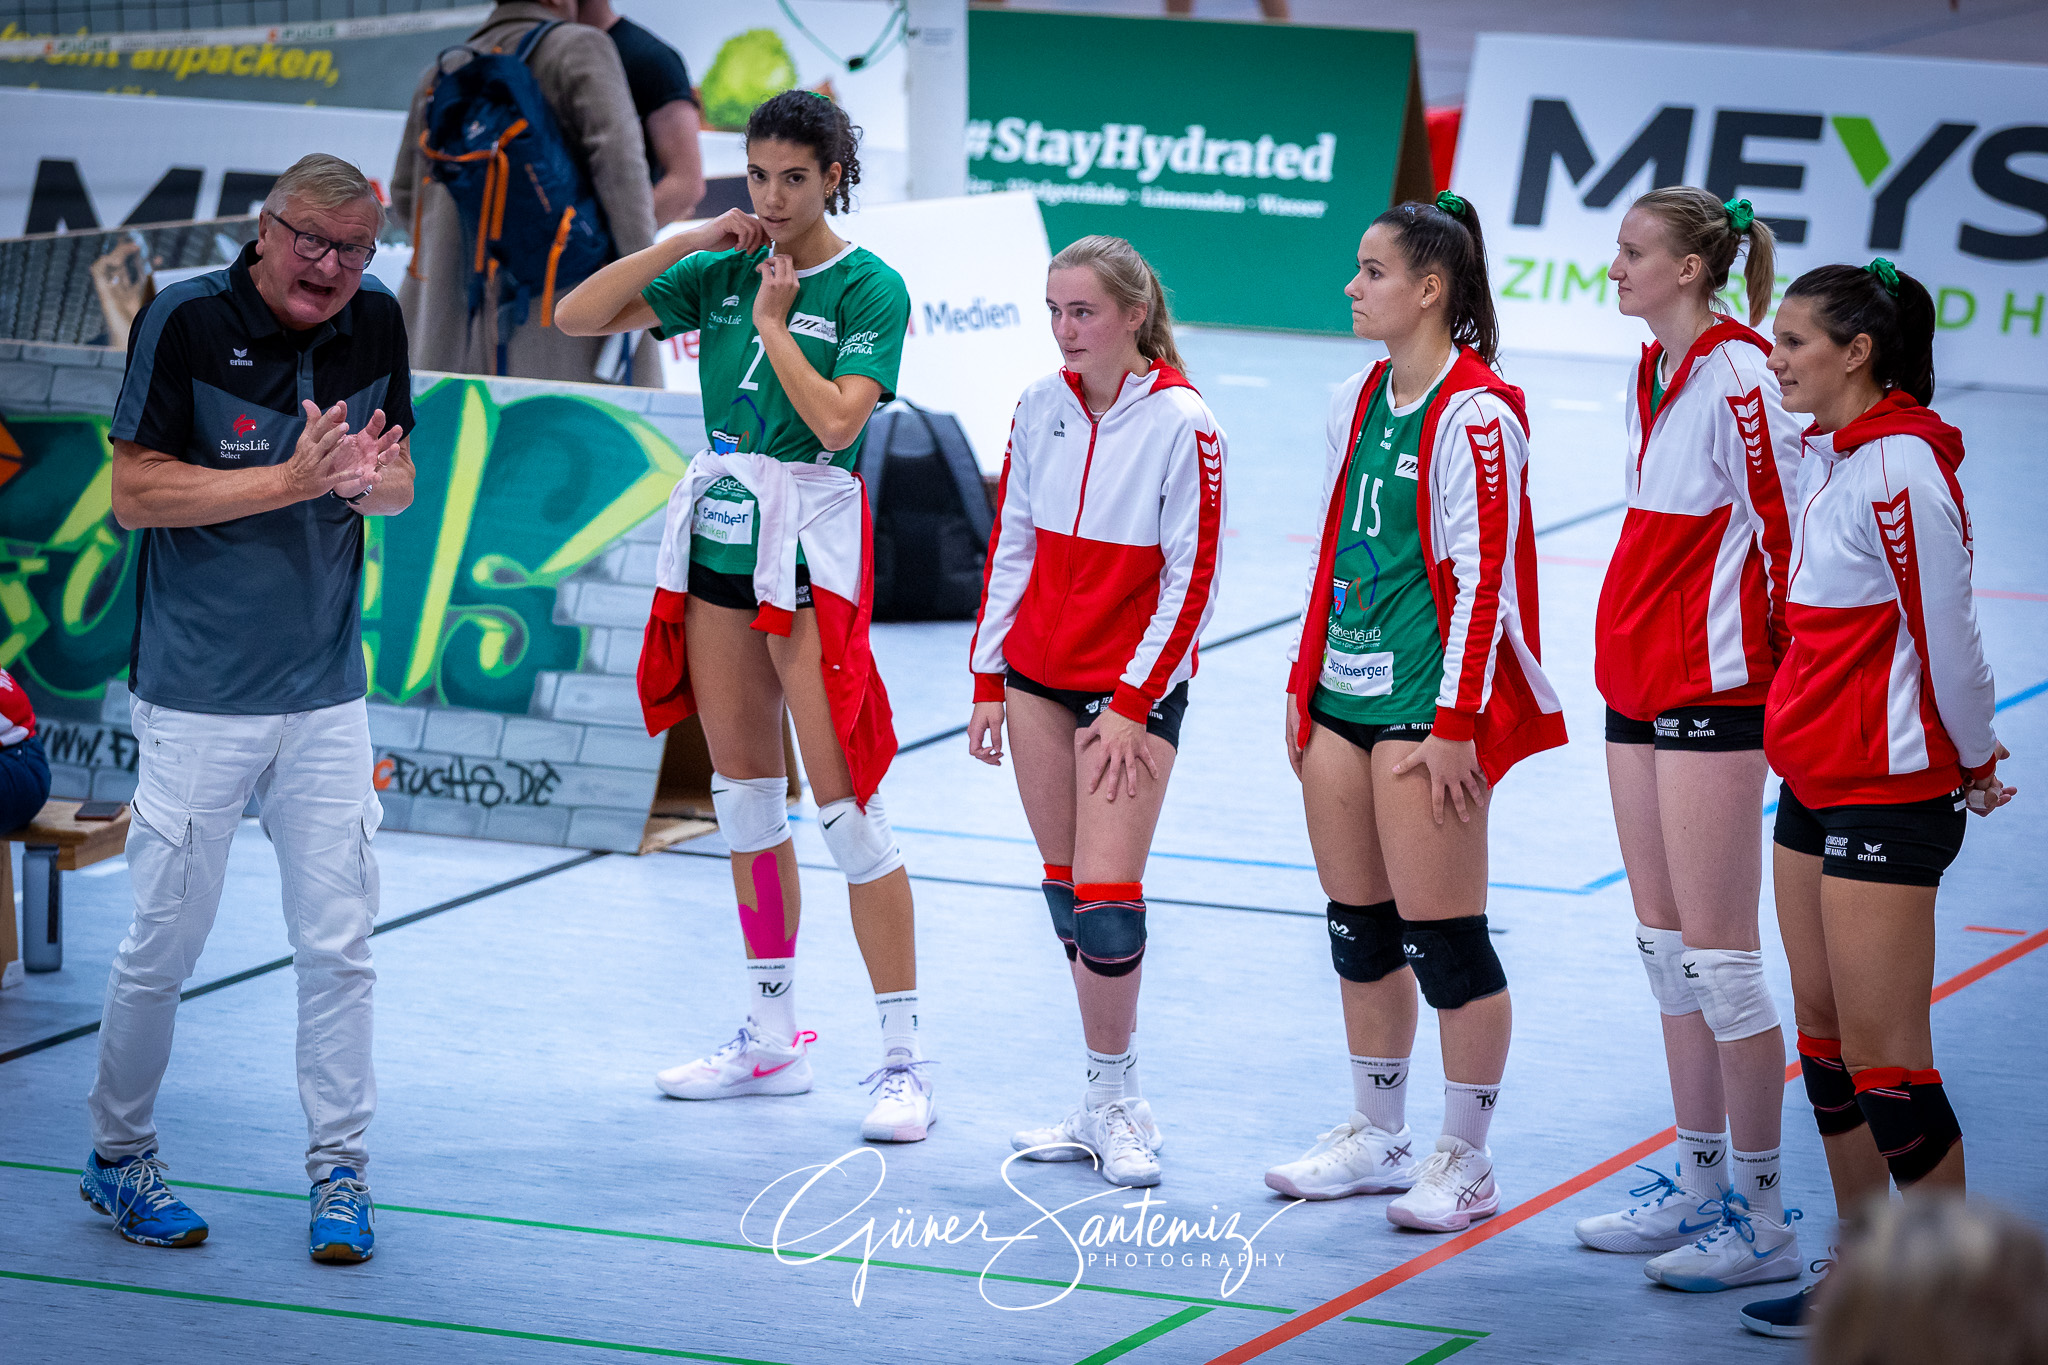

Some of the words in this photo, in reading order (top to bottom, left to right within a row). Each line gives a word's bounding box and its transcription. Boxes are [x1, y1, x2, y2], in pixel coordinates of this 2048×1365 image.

[965, 117, 1337, 183] #StayHydrated
[924, 296, 1020, 335] Medien
[738, 334, 766, 391] 2
[1053, 430, 1065, 438] eri
[220, 439, 270, 451] SwissLife
[220, 451, 241, 459] Select
[1351, 473, 1384, 538] 15
[1411, 722, 1434, 730] erim
[1687, 729, 1716, 738] erima
[1857, 853, 1887, 862] erima
[758, 981, 783, 994] TV
[1367, 1072, 1400, 1086] TV
[1693, 1150, 1719, 1164] TV
[1755, 1172, 1778, 1188] TV
